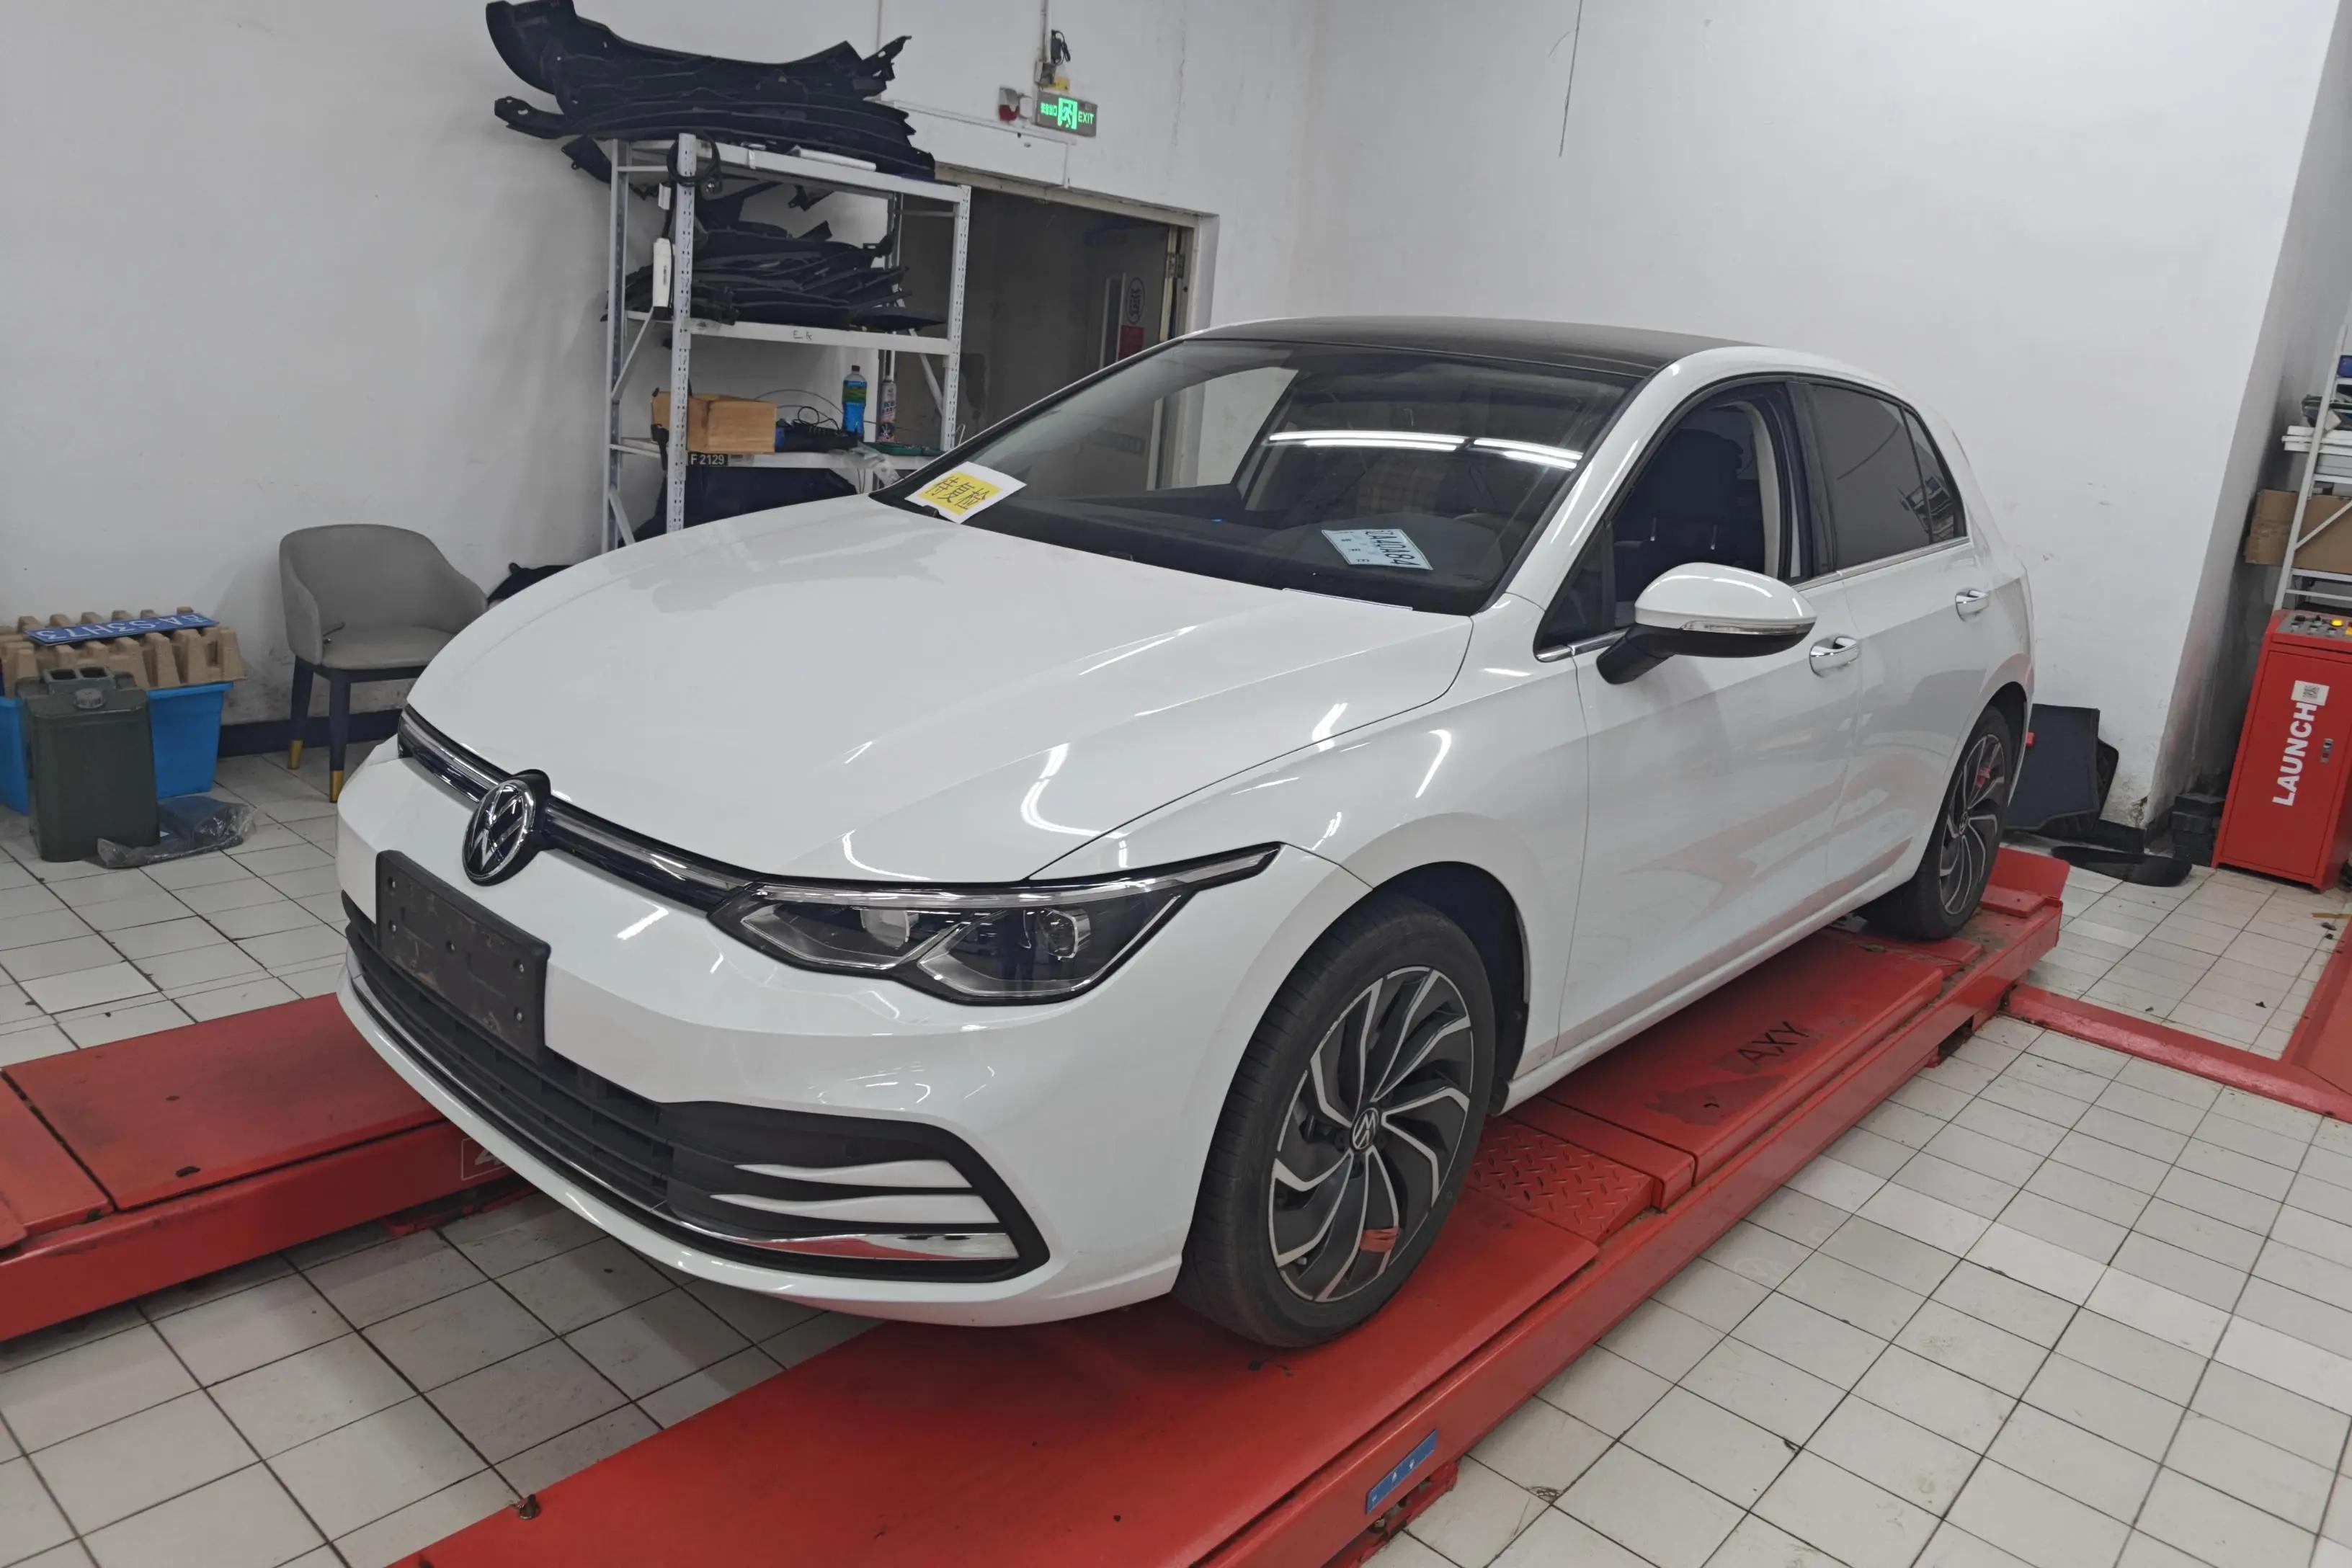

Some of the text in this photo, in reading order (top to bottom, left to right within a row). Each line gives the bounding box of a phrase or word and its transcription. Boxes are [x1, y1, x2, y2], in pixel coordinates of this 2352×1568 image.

[1078, 111, 1095, 125] EXIT
[690, 454, 725, 465] F 2129
[2272, 702, 2318, 806] LAUNCH
[1737, 1020, 1809, 1064] AXY
